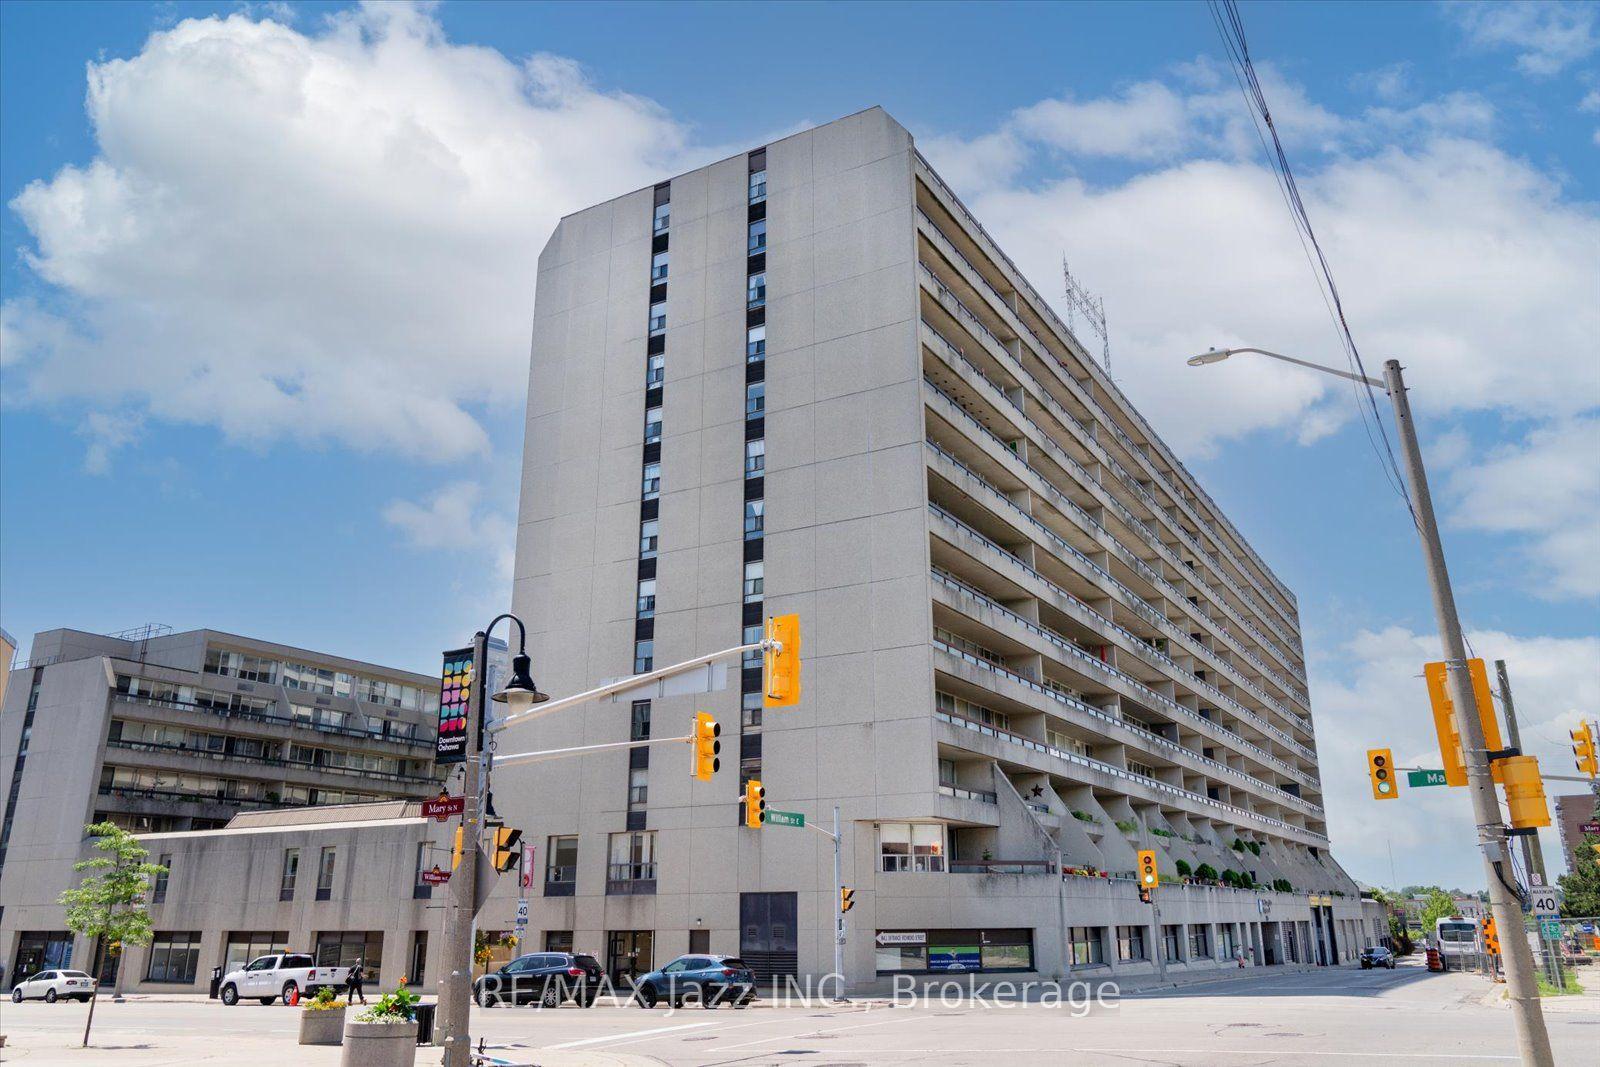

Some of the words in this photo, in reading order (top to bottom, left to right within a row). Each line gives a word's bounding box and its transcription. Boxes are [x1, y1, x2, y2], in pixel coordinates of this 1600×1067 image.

[438, 735, 466, 744] Downtown
[438, 743, 460, 752] Oshawa
[428, 803, 447, 814] Mary
[1536, 897, 1556, 911] 40
[518, 906, 528, 916] 40
